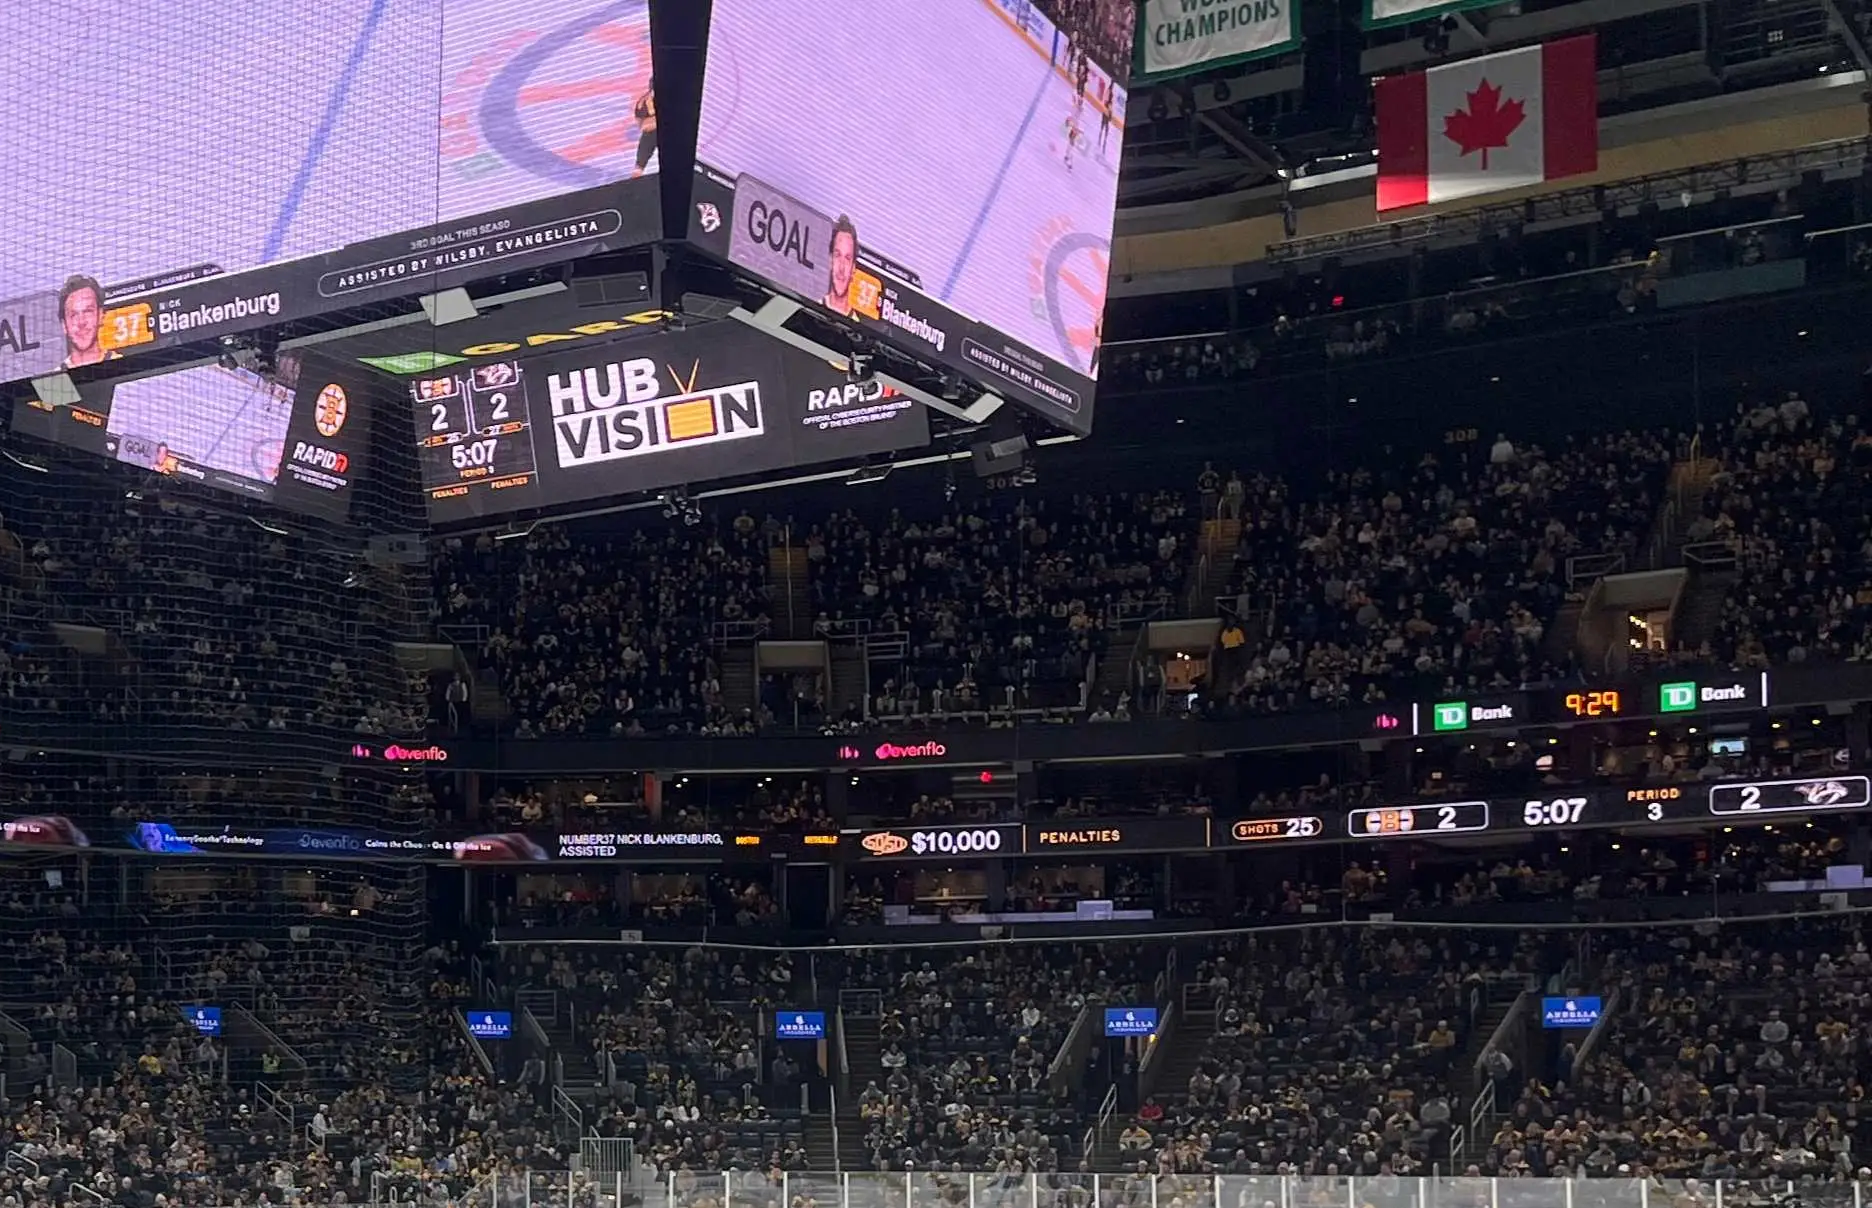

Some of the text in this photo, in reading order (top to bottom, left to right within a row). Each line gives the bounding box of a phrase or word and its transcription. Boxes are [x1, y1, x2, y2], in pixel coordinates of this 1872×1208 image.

[1155, 1, 1280, 46] CHAMPIONS
[748, 200, 814, 270] GOAL
[338, 264, 405, 288] ASSISTED
[411, 258, 427, 272] BY
[495, 220, 599, 253] EVANGELISTA
[159, 298, 181, 311] NCK
[858, 278, 878, 307] 37
[159, 292, 280, 335] Blankenburg
[882, 299, 945, 351] Blankenburg
[113, 313, 140, 343] 37
[547, 358, 660, 416] HUB
[432, 404, 448, 431] 2
[491, 393, 509, 420] 2
[452, 439, 497, 468] 5:07
[1566, 691, 1619, 716] 9:29
[1669, 684, 1745, 707] TD Bank
[1438, 704, 1513, 725] TD Bank
[889, 742, 945, 758] evenflo
[1628, 788, 1679, 802] PERIOD
[1740, 786, 1761, 810] 2
[1437, 807, 1456, 829] 2
[1523, 798, 1587, 826] 5:07
[1647, 802, 1663, 821] 3
[1040, 829, 1120, 844] PENALTIES
[1240, 817, 1315, 837] SHOTS 25
[559, 845, 616, 857] ASSISTED
[617, 834, 641, 845] NICK
[643, 833, 724, 847] BLANKENBURG,
[912, 829, 1000, 855] $10,000
